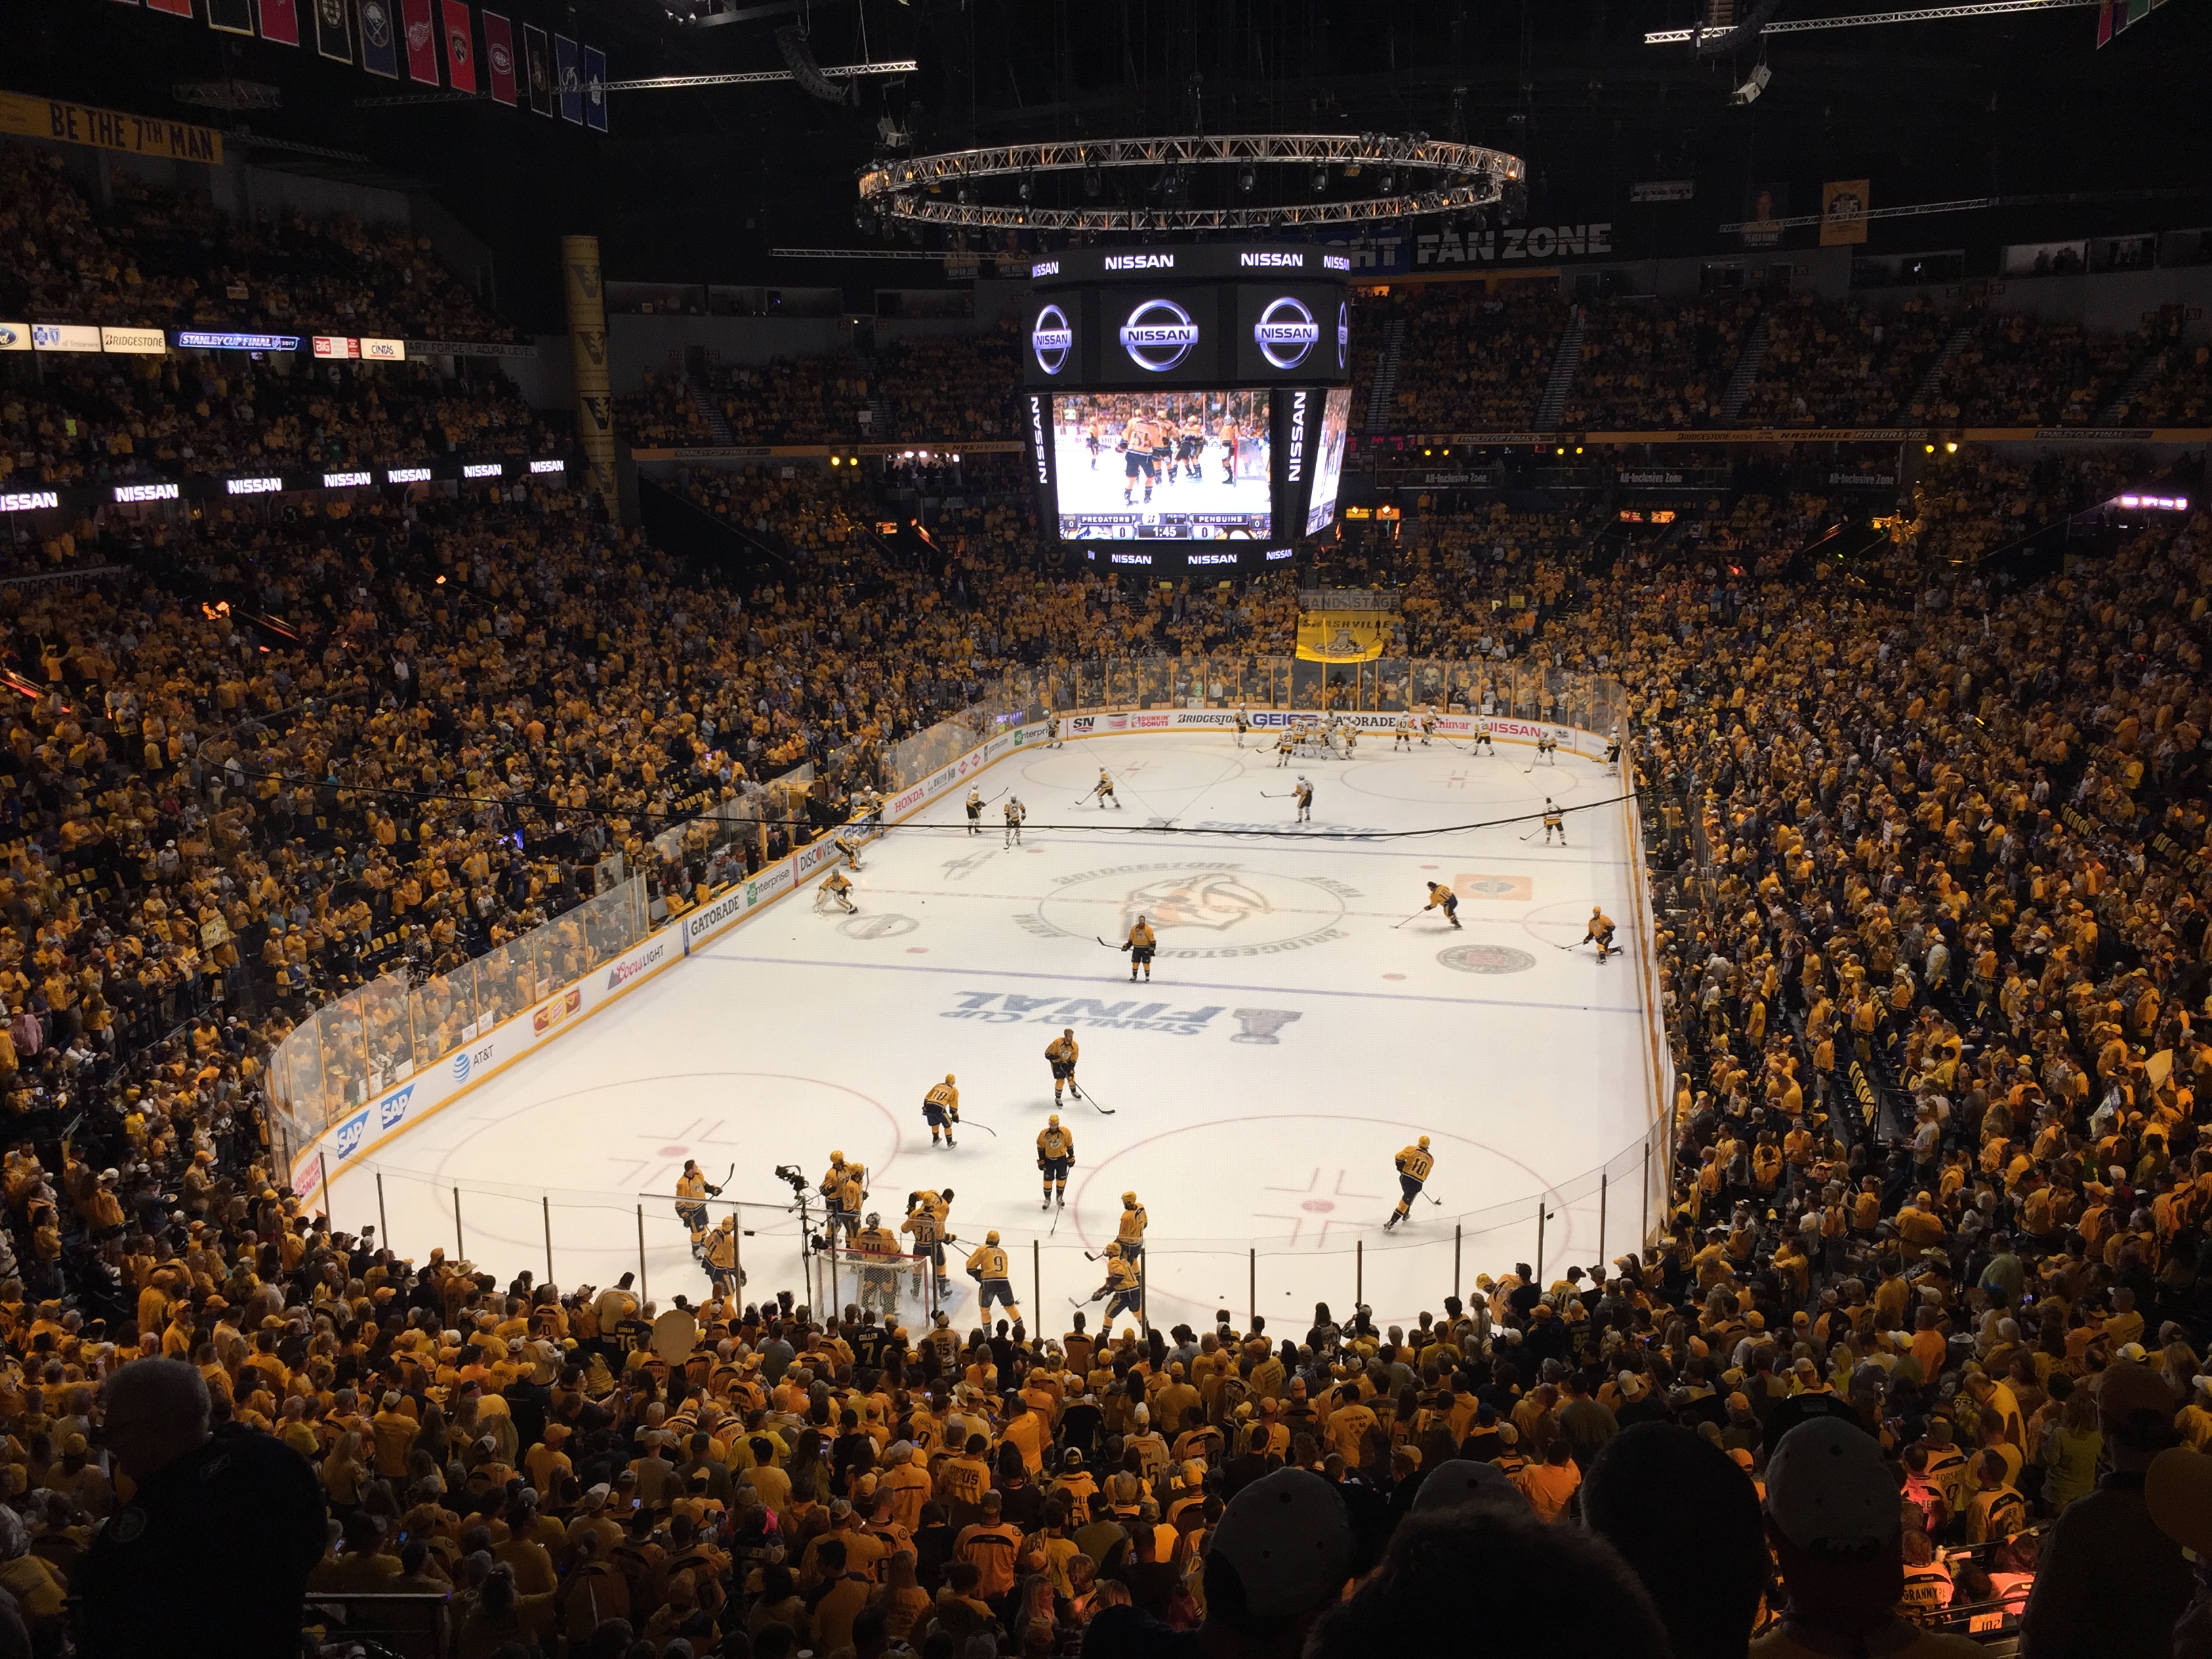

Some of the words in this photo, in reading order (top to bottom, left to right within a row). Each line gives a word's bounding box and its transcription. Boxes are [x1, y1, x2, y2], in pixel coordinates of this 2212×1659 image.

[49, 102, 79, 140] BE
[86, 110, 126, 148] THE
[133, 118, 164, 151] 7TH
[169, 124, 214, 161] MAN
[1417, 230, 1495, 265] FAN
[1502, 222, 1613, 260] ZONE
[1105, 254, 1174, 270] NISSAN
[1241, 253, 1303, 266] NISSAN
[1324, 255, 1350, 270] NISSAN
[105, 334, 163, 347] BRIDGESTONE
[1037, 334, 1068, 345] NISSAN
[1128, 330, 1190, 342] NISSAN
[1261, 328, 1312, 339] NISSAN
[70, 340, 100, 348] Tennessee
[182, 335, 224, 345] STANLEY
[224, 335, 242, 346] CUP
[242, 337, 272, 348] FINAL
[371, 342, 394, 355] CINTAS
[408, 342, 428, 352] ARY
[431, 344, 465, 353] FORCE
[476, 345, 506, 354] ACURA
[509, 347, 535, 356] LEVEL
[1031, 396, 1048, 485] NISSAN
[1288, 391, 1307, 482] NISSAN
[1856, 430, 1929, 438] PREDATORS
[2037, 430, 2074, 438] STANLEY
[464, 464, 502, 478] NISSAN
[530, 459, 565, 473] NISSAN
[323, 471, 371, 488] NISSAN
[388, 468, 431, 483] NISSAN
[1470, 472, 1488, 483] Zone
[1665, 472, 1683, 483] Zone
[1876, 473, 1896, 485] Zone
[115, 483, 179, 503] NISSAN
[228, 477, 282, 495] NISSAN
[0, 492, 58, 512] ISSAN
[1120, 527, 1126, 537] 0
[1153, 527, 1176, 537] 1:45
[1202, 527, 1208, 537] 0
[1111, 554, 1152, 565] NISSAN
[1187, 554, 1237, 565] NISSAN
[1266, 549, 1293, 560] NISSAN
[1302, 597, 1343, 608] BAND
[1353, 597, 1397, 608] STAGE
[1073, 716, 1094, 730] SN
[1177, 714, 1235, 724] BRIDGESTO
[1016, 726, 1049, 743] enterpri
[1296, 724, 1305, 732] 72
[1283, 735, 1292, 743] 23
[895, 787, 924, 813] HONDA
[800, 836, 836, 872] DISCOVER
[1052, 861, 1247, 884] BRIDGESTONE
[747, 868, 790, 901] enterprise
[691, 895, 741, 937] GATORADE
[1154, 928, 1350, 958] BRIDGESTON
[616, 960, 644, 983] Coors
[642, 944, 664, 967] LIGHT
[953, 989, 1227, 1024] FINAL
[939, 1007, 1012, 1025] CUP
[1018, 1012, 1209, 1036] STANLEY
[472, 1044, 495, 1068] AT&T
[382, 1093, 409, 1125] SAP
[337, 1120, 363, 1152] SAP
[1411, 1158, 1428, 1176] 10
[994, 1256, 1004, 1273] 9
[616, 1334, 638, 1352] 76
[935, 1343, 950, 1356] 35
[861, 1343, 876, 1366] 7
[1903, 1587, 1937, 1601] GRANNY
